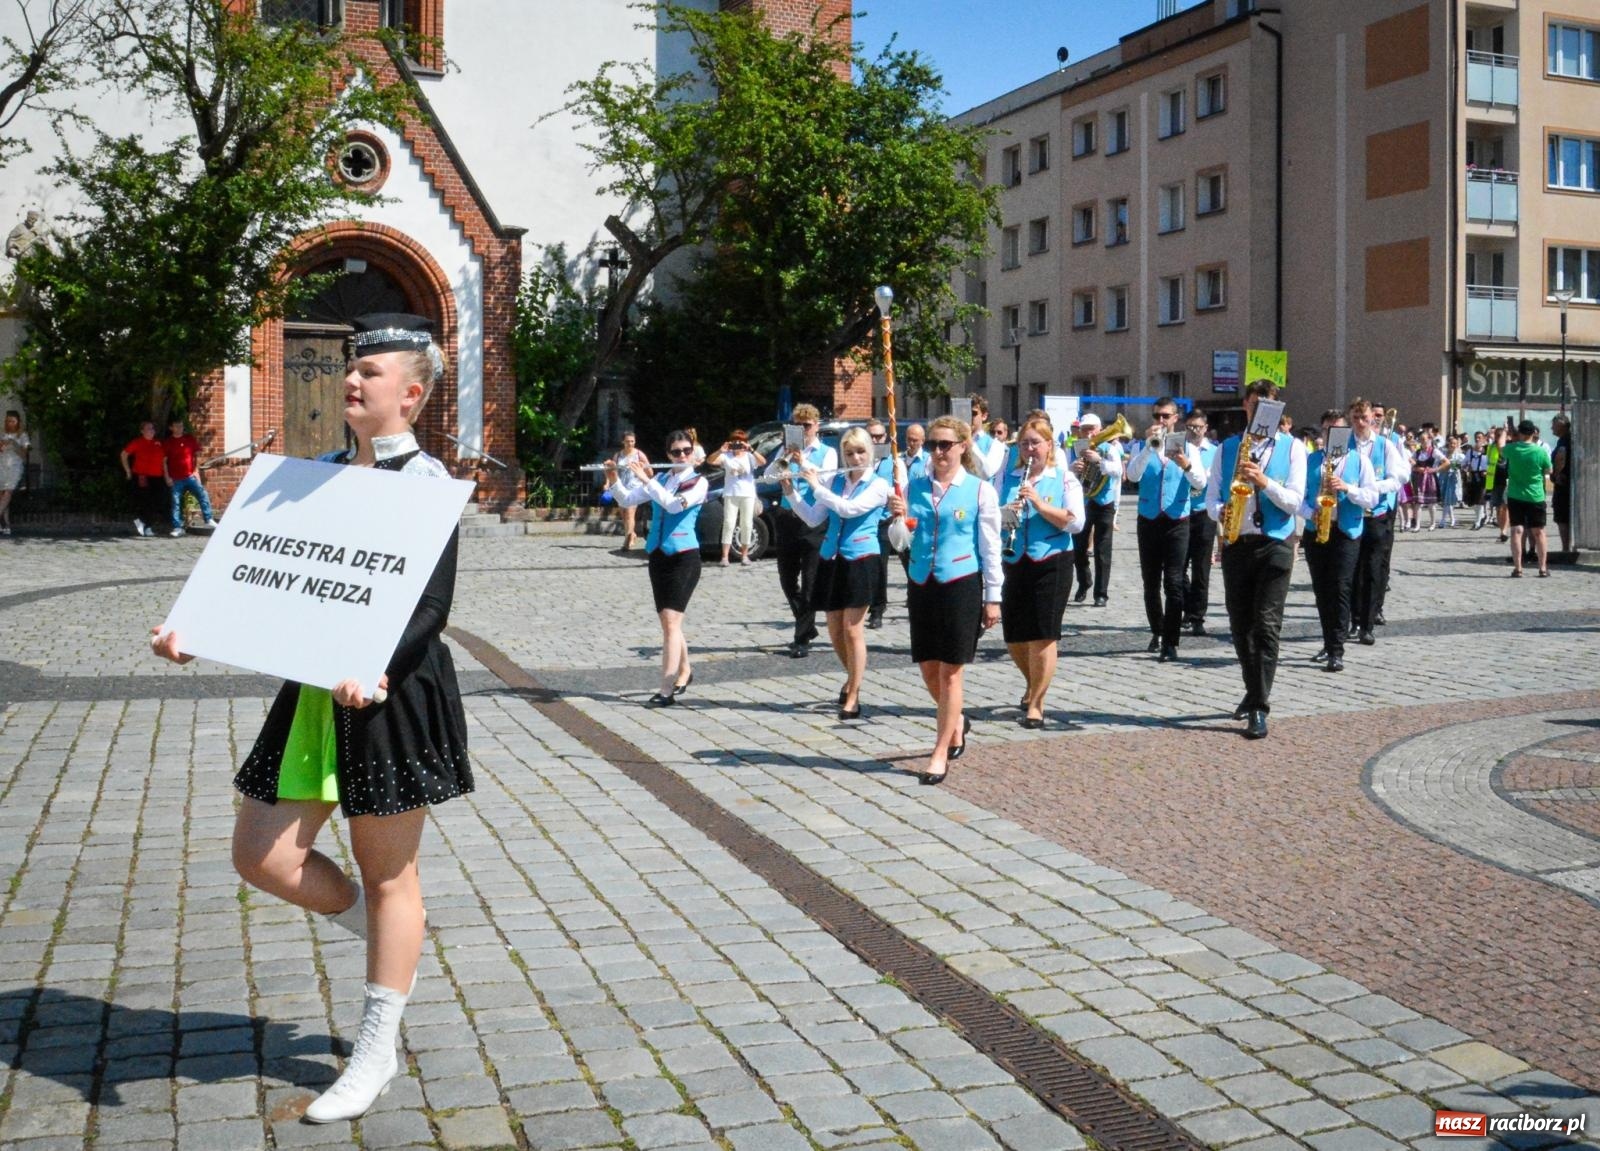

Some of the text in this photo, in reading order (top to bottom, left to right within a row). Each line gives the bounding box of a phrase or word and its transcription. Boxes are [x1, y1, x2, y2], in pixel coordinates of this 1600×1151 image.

[232, 530, 407, 576] ORKIESTRA DĘTA
[232, 564, 373, 606] GMINY NĘDZA
